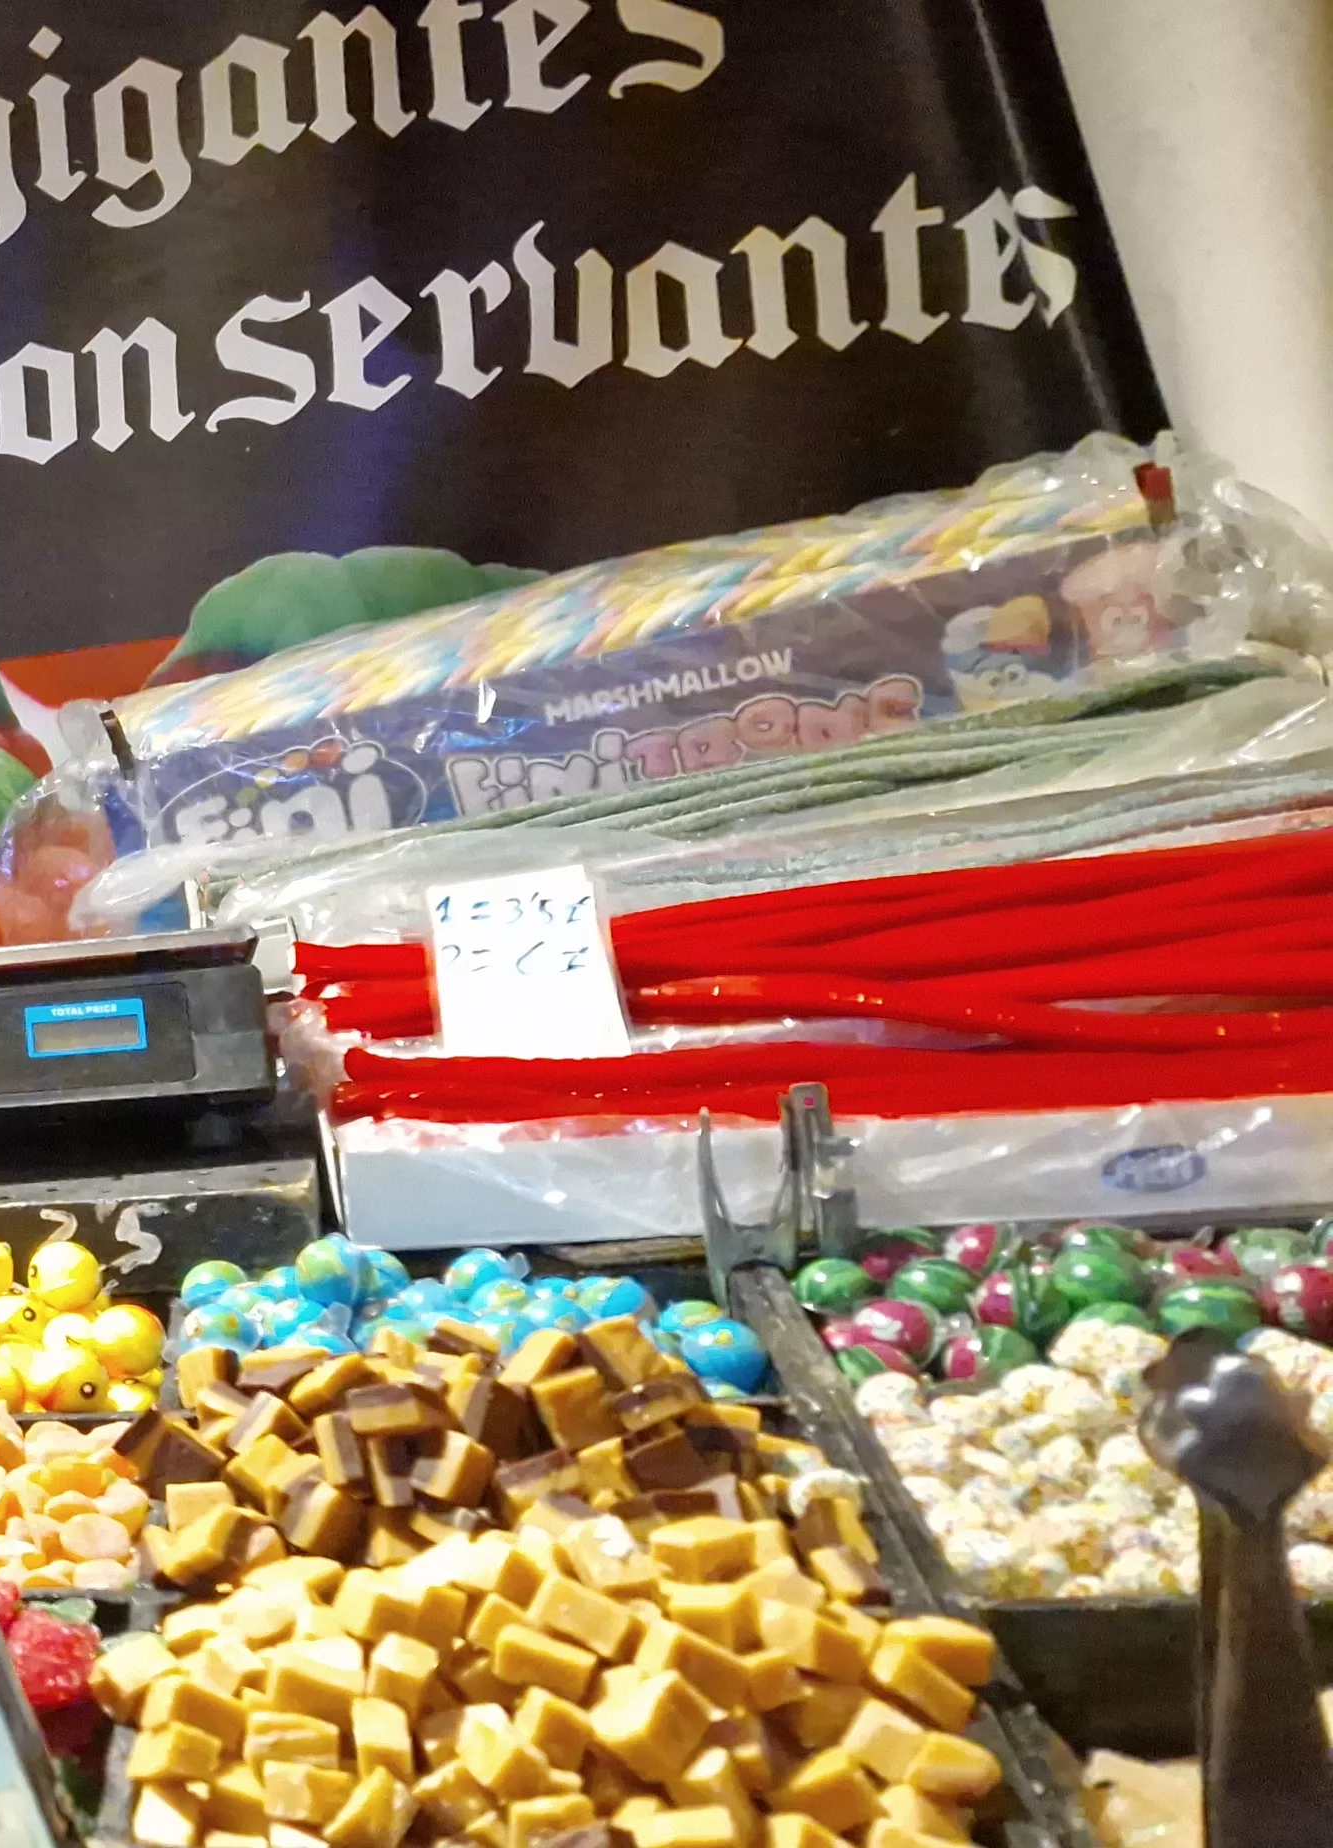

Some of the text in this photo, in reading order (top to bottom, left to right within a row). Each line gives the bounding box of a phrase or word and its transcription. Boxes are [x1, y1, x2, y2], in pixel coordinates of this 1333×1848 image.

[543, 648, 794, 727] MARSHMALLOW
[50, 1003, 118, 1017] TOTAL PRICE
